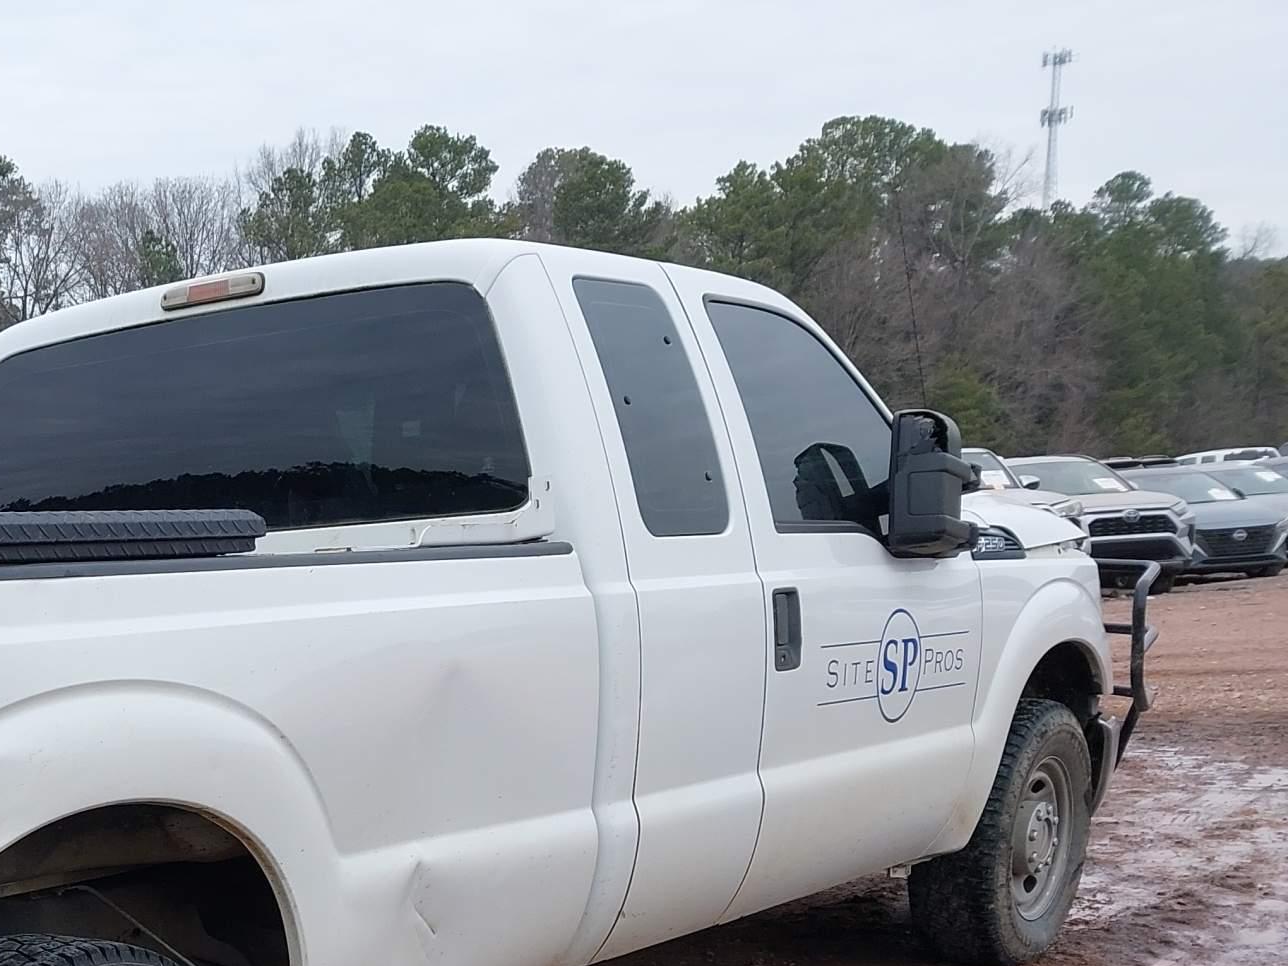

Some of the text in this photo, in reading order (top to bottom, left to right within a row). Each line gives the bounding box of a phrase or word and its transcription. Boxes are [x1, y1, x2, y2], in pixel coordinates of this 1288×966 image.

[827, 638, 964, 695] SITE SP PROS
